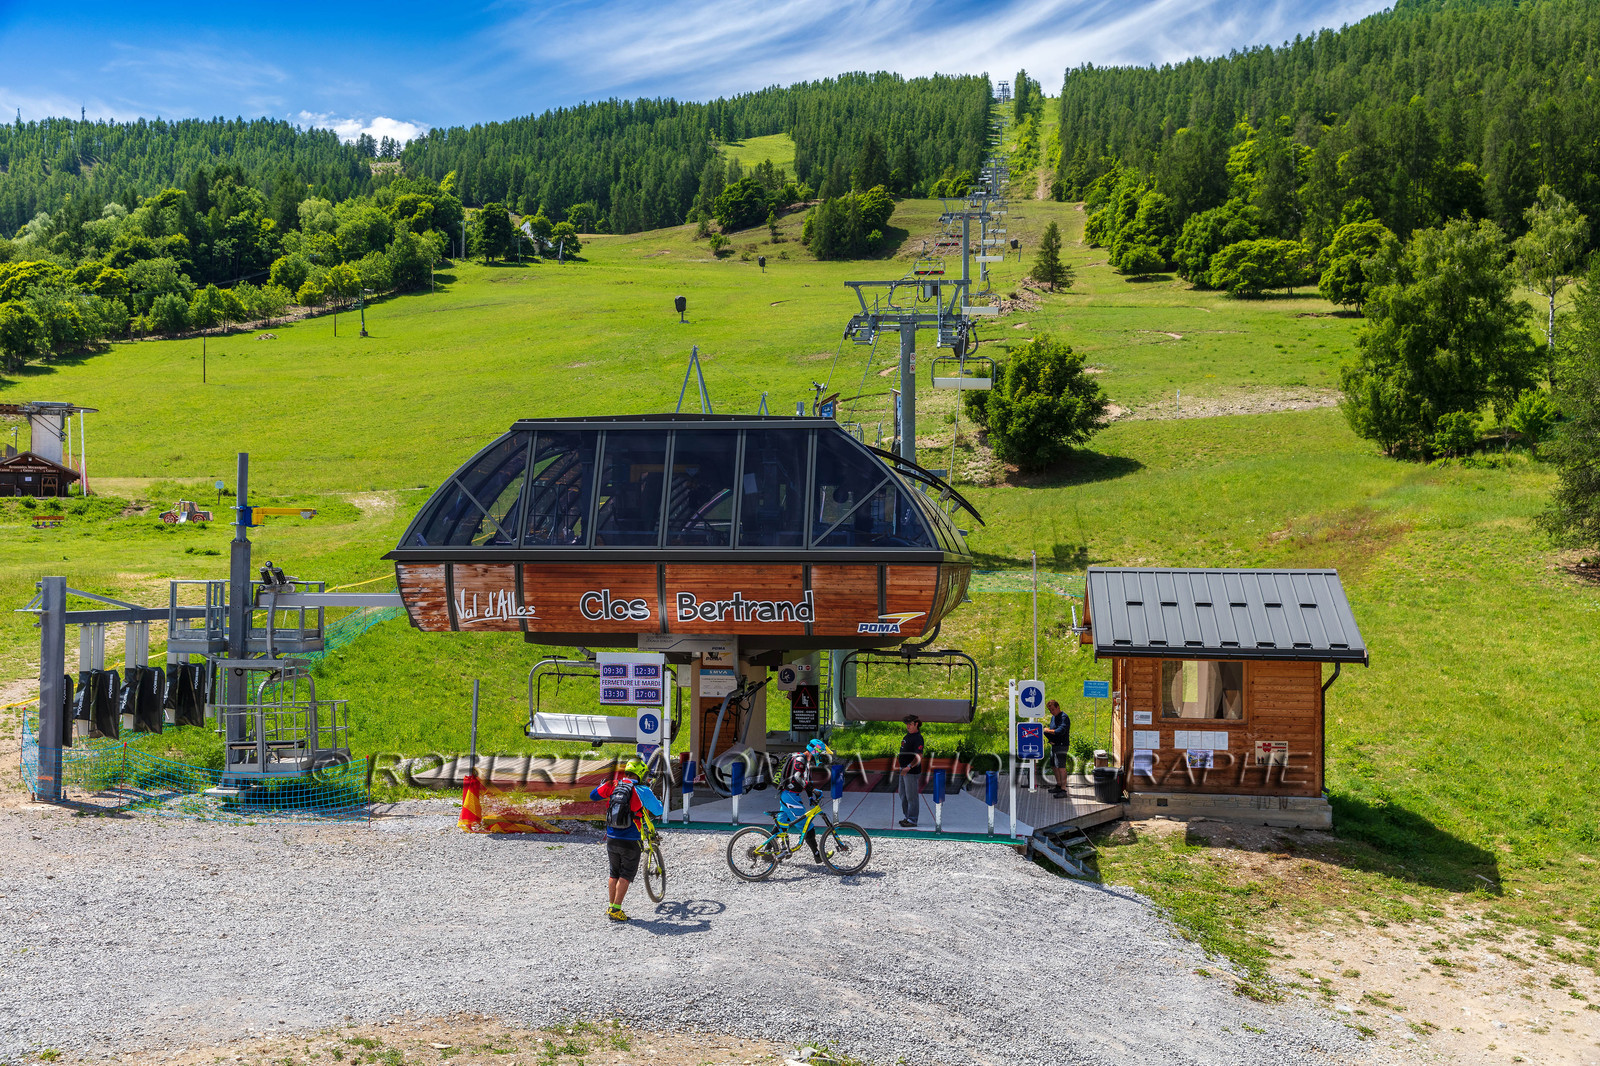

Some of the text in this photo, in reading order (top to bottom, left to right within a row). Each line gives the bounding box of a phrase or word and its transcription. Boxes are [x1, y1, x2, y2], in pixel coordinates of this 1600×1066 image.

[455, 588, 536, 621] Val d'Allos
[580, 589, 815, 623] Clos Bertrand
[857, 623, 900, 633] POMA
[635, 667, 656, 675] 12:30
